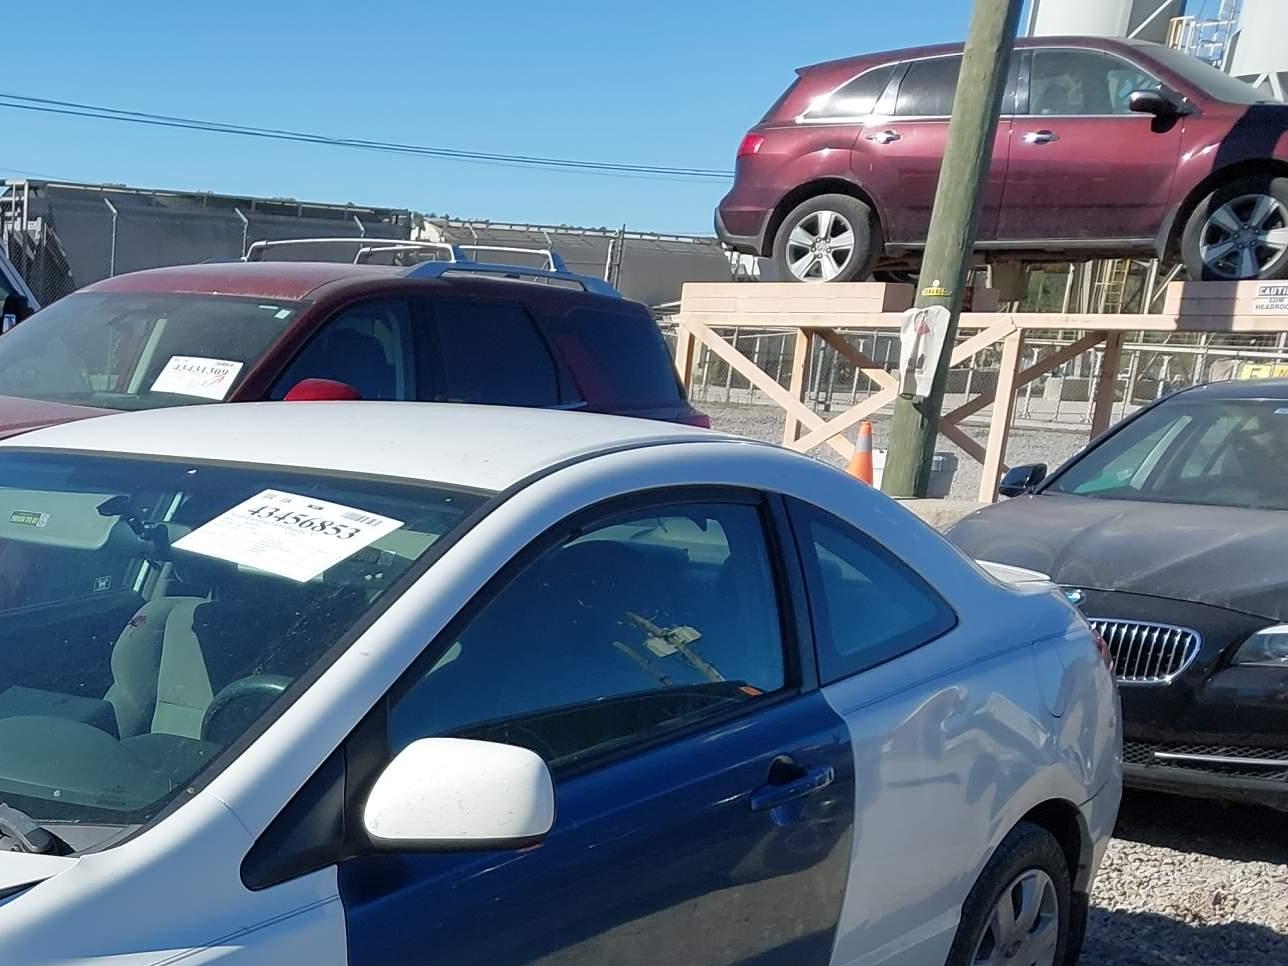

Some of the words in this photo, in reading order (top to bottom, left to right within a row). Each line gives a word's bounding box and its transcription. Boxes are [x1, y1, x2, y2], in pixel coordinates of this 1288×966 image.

[1259, 286, 1288, 295] CAUTI
[172, 363, 229, 376] 43431309
[247, 503, 362, 541] 43456853
